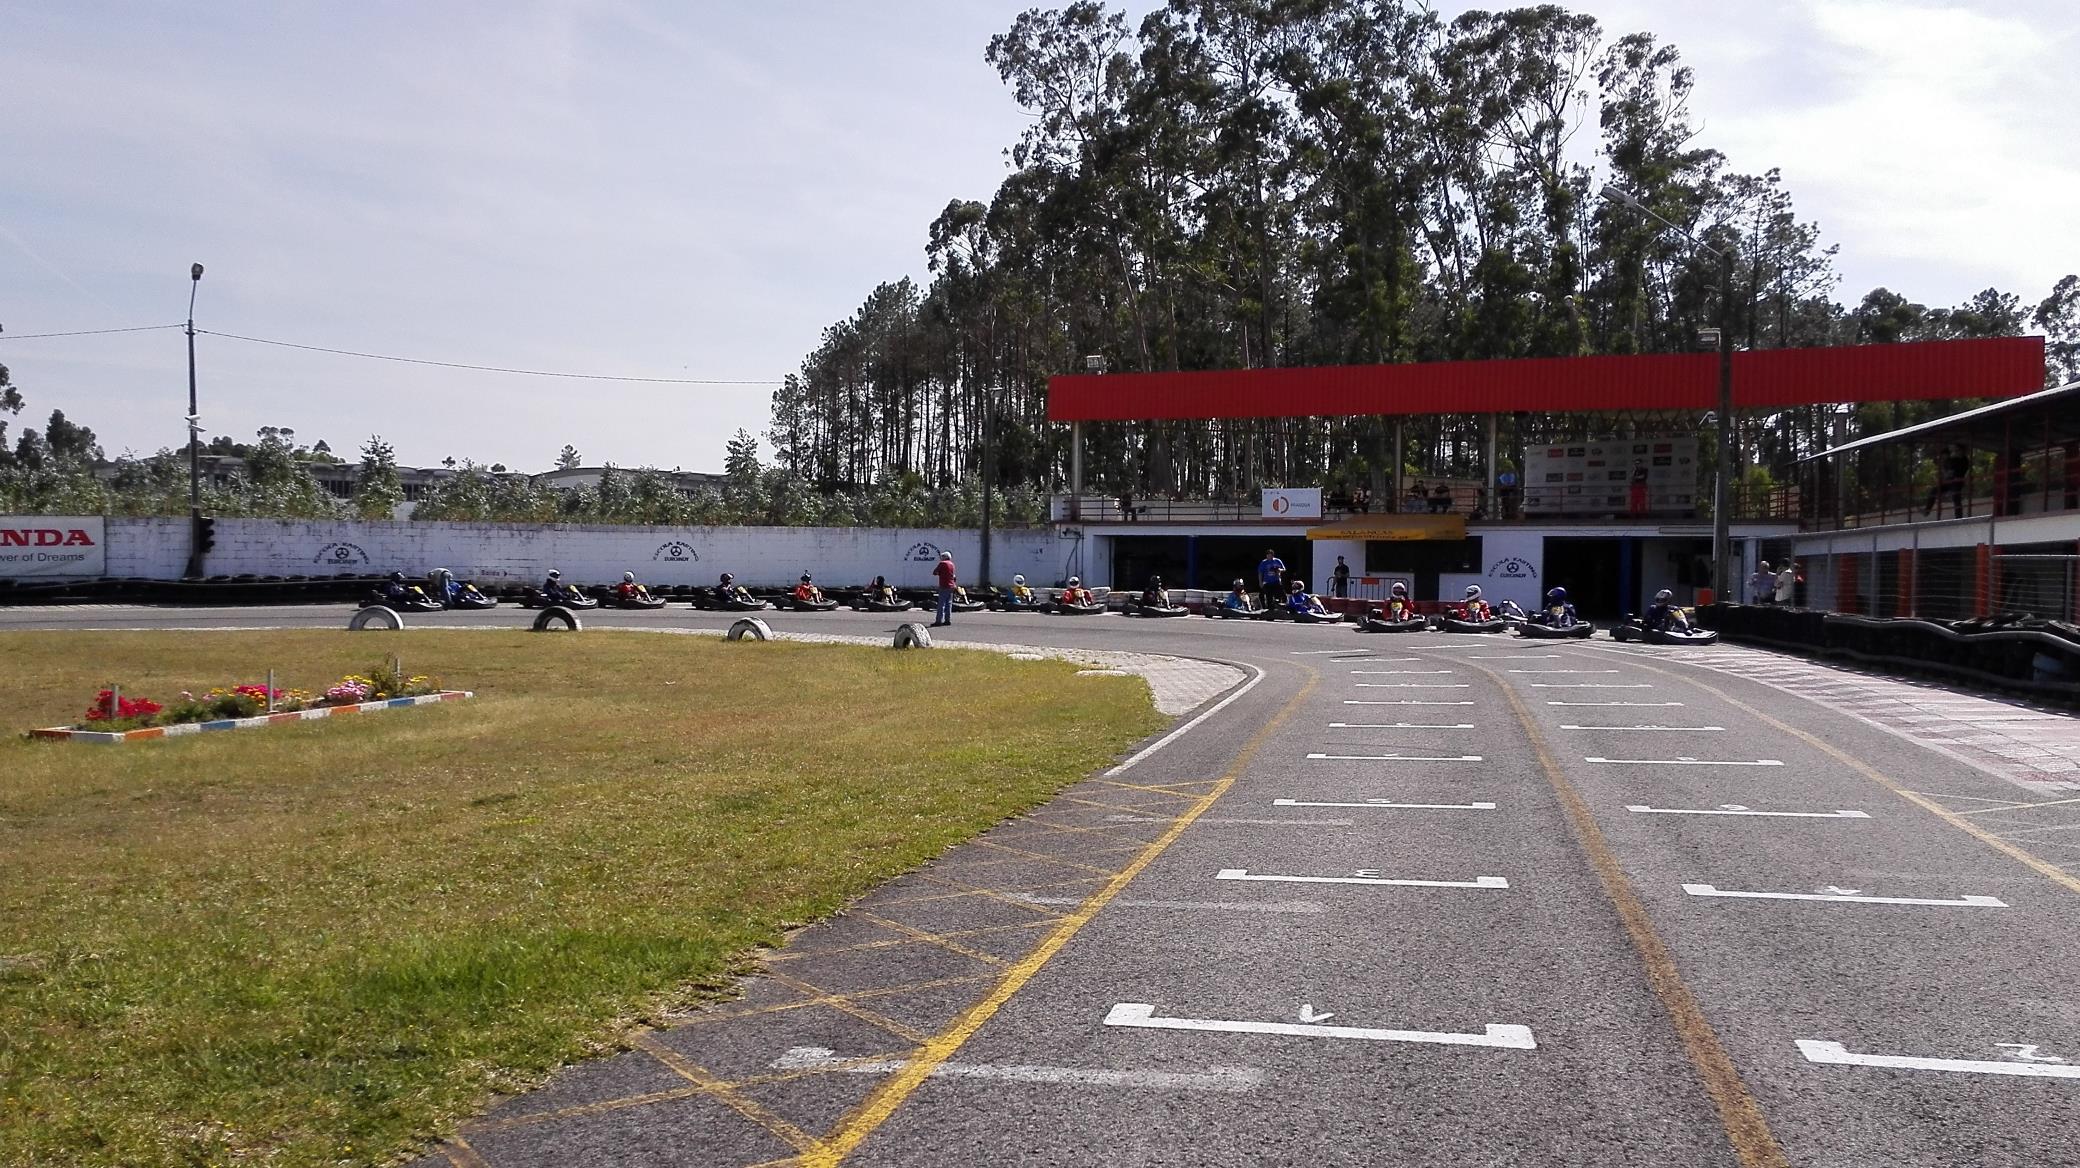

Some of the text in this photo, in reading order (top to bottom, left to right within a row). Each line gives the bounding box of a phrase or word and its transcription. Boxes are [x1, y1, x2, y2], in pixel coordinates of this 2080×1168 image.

[22, 553, 34, 561] of
[38, 552, 85, 561] Dreams
[653, 541, 699, 561] ESCOLA KARTING
[1488, 557, 1537, 578] ESCOLA KARTING
